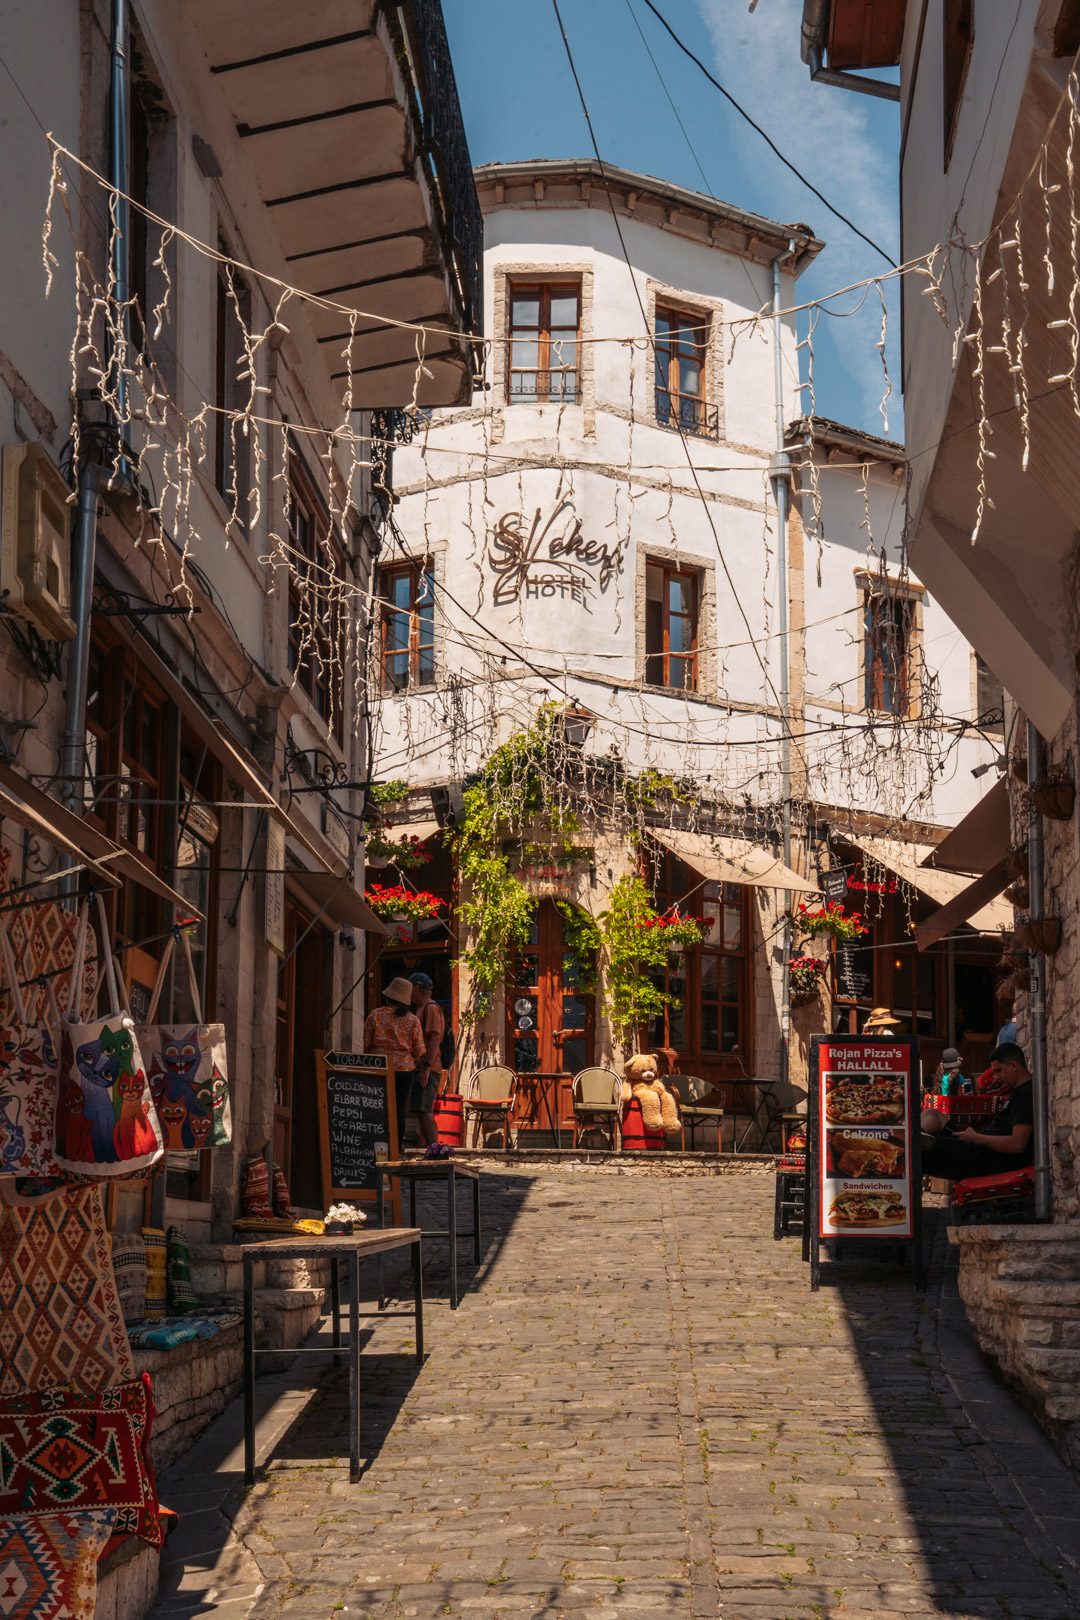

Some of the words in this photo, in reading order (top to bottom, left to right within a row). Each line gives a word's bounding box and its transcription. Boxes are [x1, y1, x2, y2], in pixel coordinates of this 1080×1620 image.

[525, 574, 592, 589] HOTEL
[334, 1054, 382, 1067] TOBACCO
[828, 1048, 861, 1060] Rejan
[863, 1048, 902, 1058] Pizza's
[837, 1061, 892, 1070] HALLALL
[327, 1076, 352, 1091] COLD
[352, 1082, 385, 1098] DRINKS
[362, 1096, 385, 1110] BEER
[332, 1106, 363, 1119] PEPSI
[332, 1118, 385, 1134] CIGARETTE
[332, 1130, 362, 1146] WINE
[842, 1129, 889, 1140] Calzone
[331, 1142, 375, 1157] ALBANIAN
[334, 1155, 376, 1169] ALCOHOLIC
[333, 1167, 367, 1180] DRINKS
[842, 1182, 894, 1190] Sandwiches
